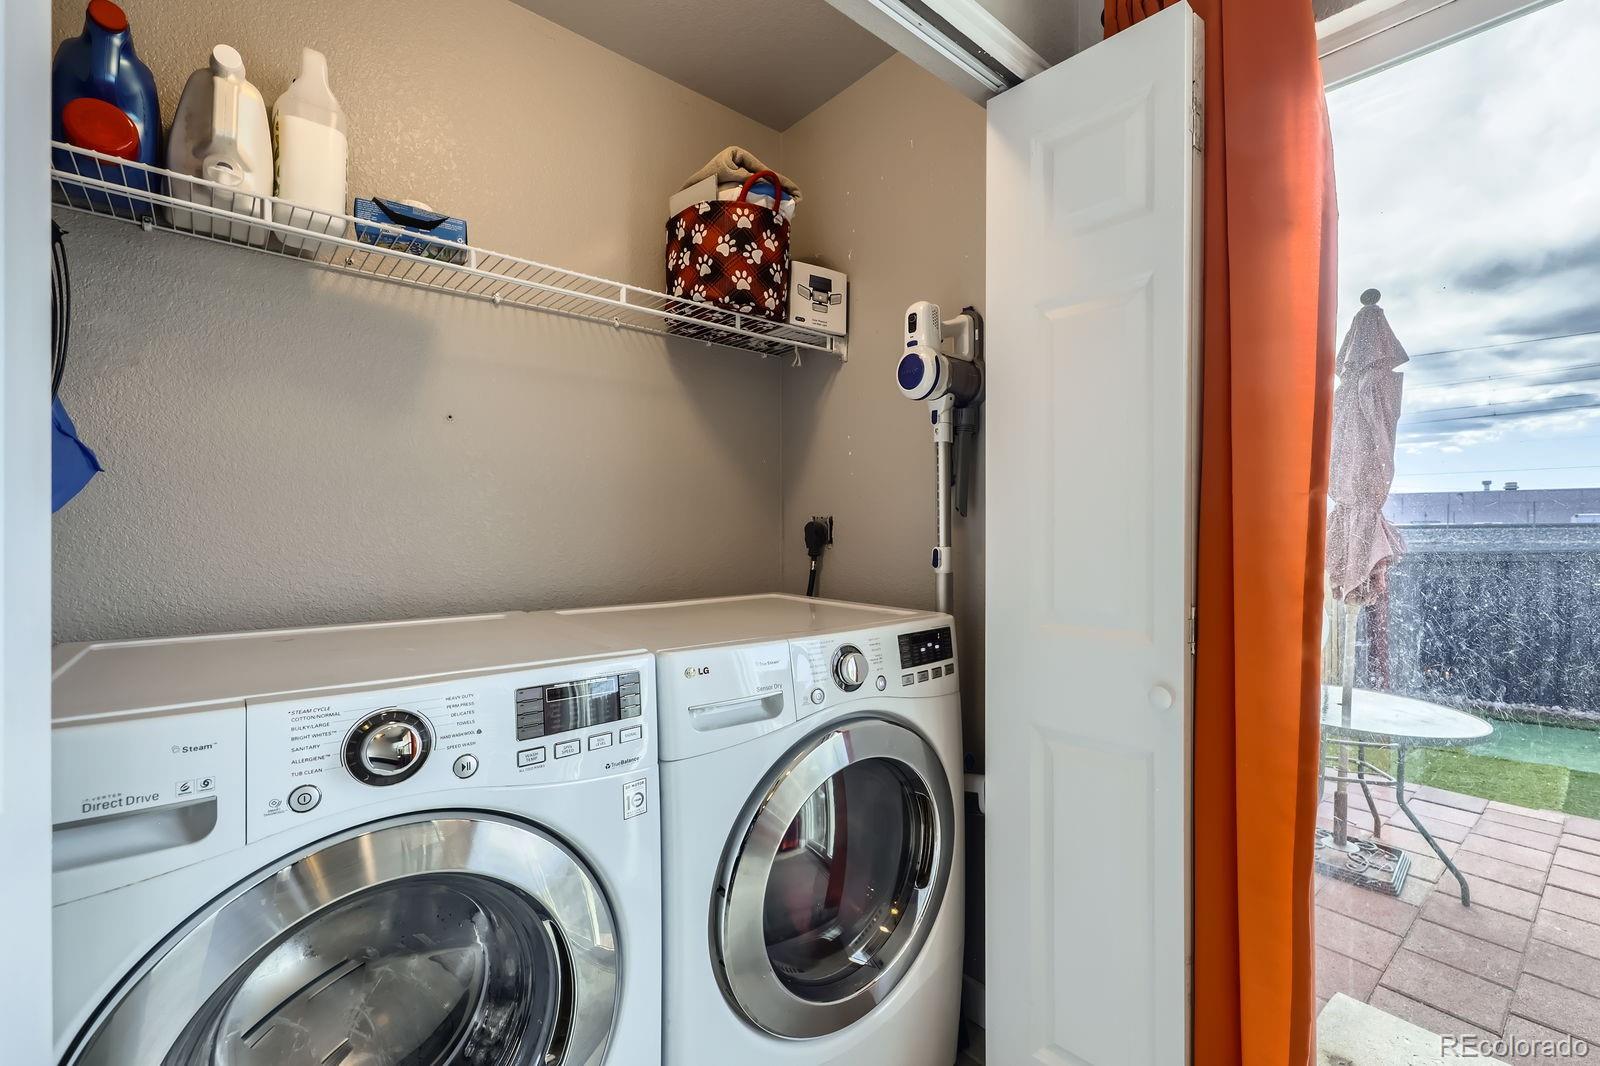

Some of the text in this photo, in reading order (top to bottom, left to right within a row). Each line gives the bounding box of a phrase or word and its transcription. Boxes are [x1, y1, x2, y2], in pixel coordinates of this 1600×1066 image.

[698, 666, 710, 675] LG
[756, 682, 783, 693] Sensor Dry
[450, 710, 475, 718] DELICATES
[290, 744, 321, 753] SANITARY
[303, 768, 323, 776] CLEAN
[82, 792, 160, 814] Direct Drive
